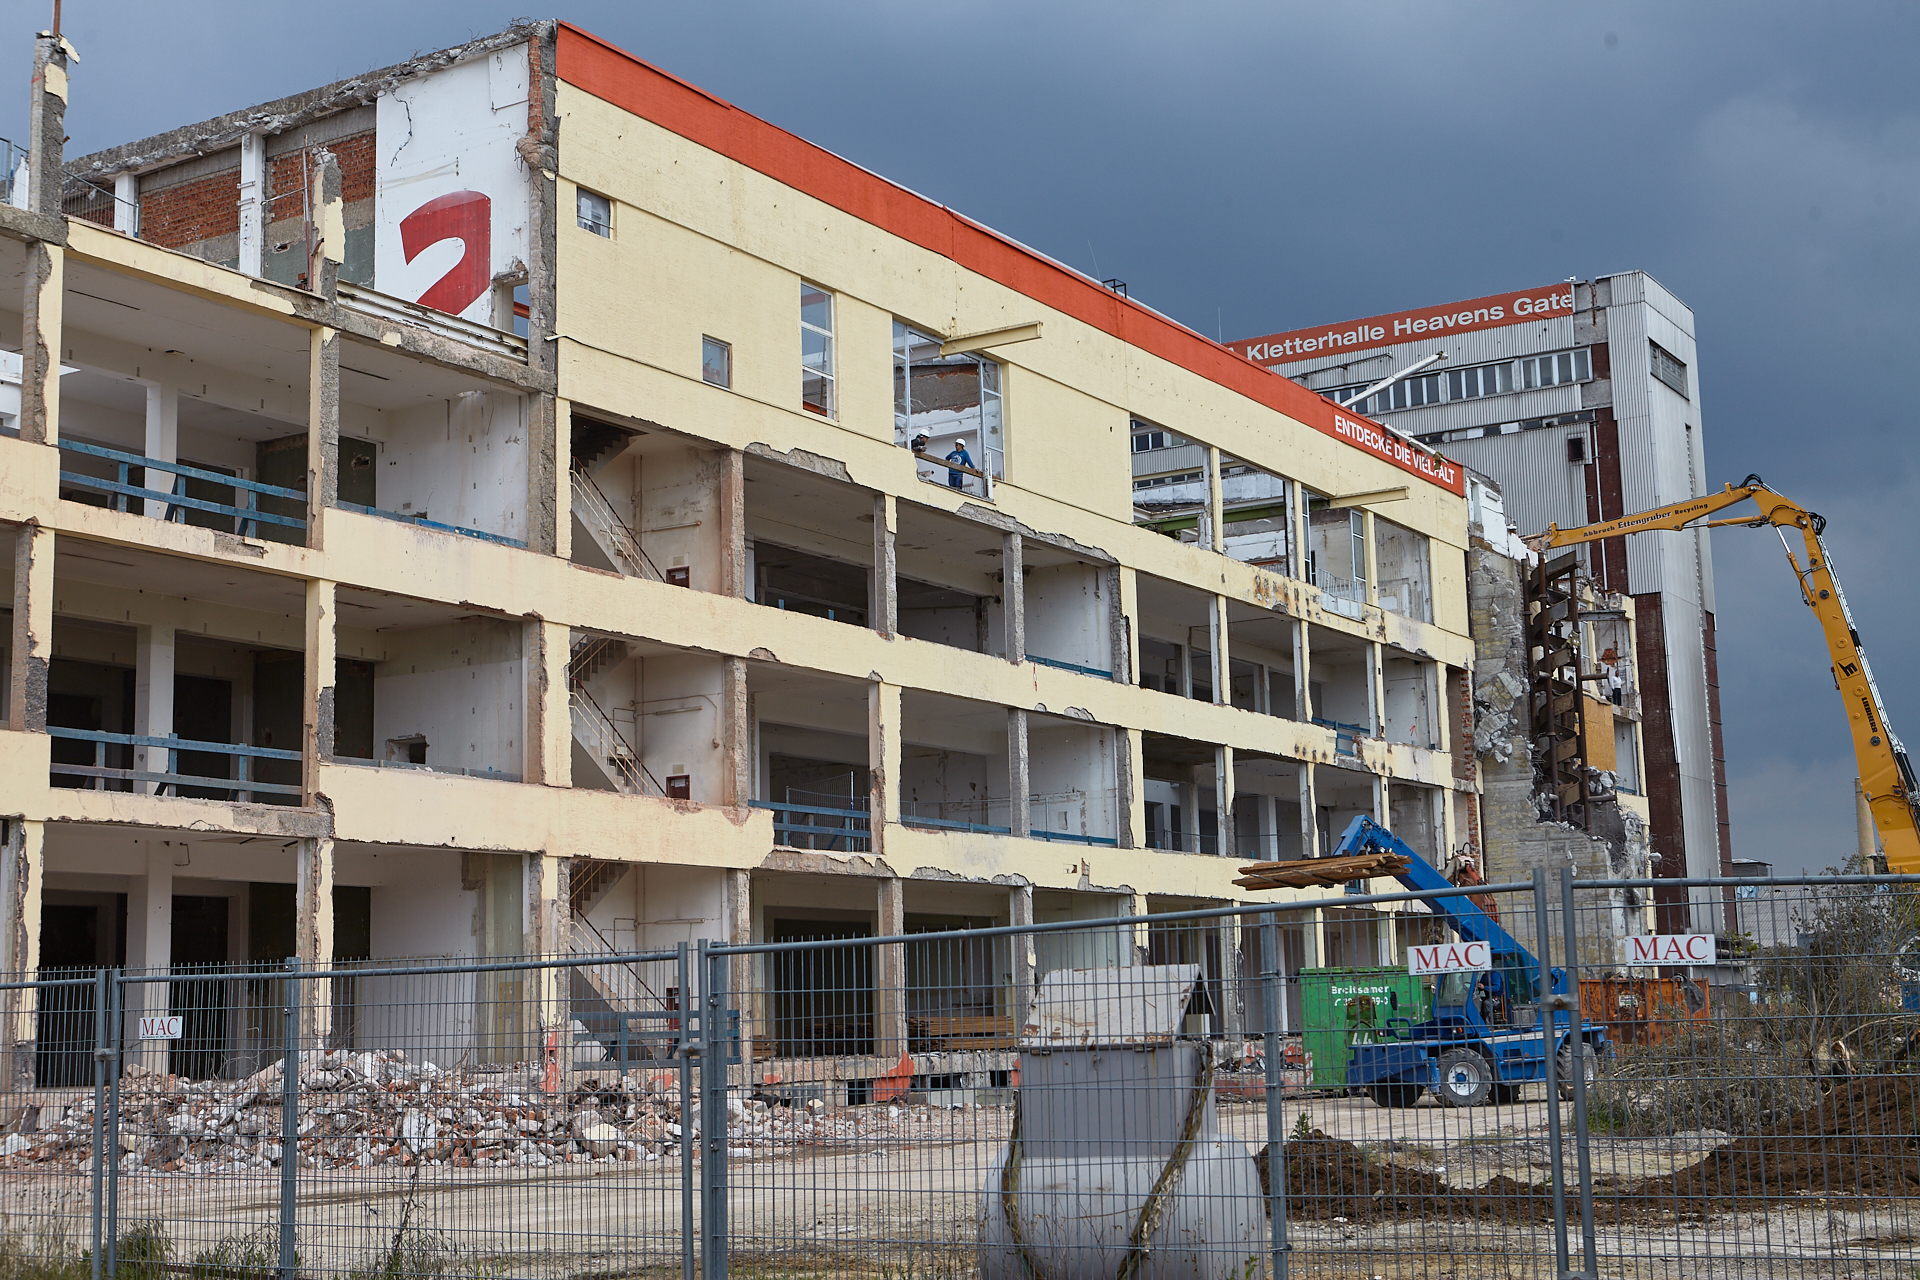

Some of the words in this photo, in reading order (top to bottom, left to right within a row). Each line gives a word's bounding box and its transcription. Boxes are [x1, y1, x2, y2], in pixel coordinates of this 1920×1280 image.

[1247, 325, 1385, 362] Kletterhalle
[1393, 305, 1504, 337] Heavens
[1513, 292, 1572, 316] Gate
[1335, 414, 1393, 456] ENTDECKE
[1394, 442, 1412, 466] DIE
[1583, 525, 1616, 538] Abbruch
[1617, 510, 1673, 530] Ettengruber
[1674, 503, 1709, 516] Recycling
[1861, 696, 1878, 734] LIEBHERR
[1414, 943, 1485, 971] MAC
[1632, 935, 1708, 961] MAC
[1331, 985, 1390, 995] Breitsamer
[142, 1017, 178, 1036] MAC
